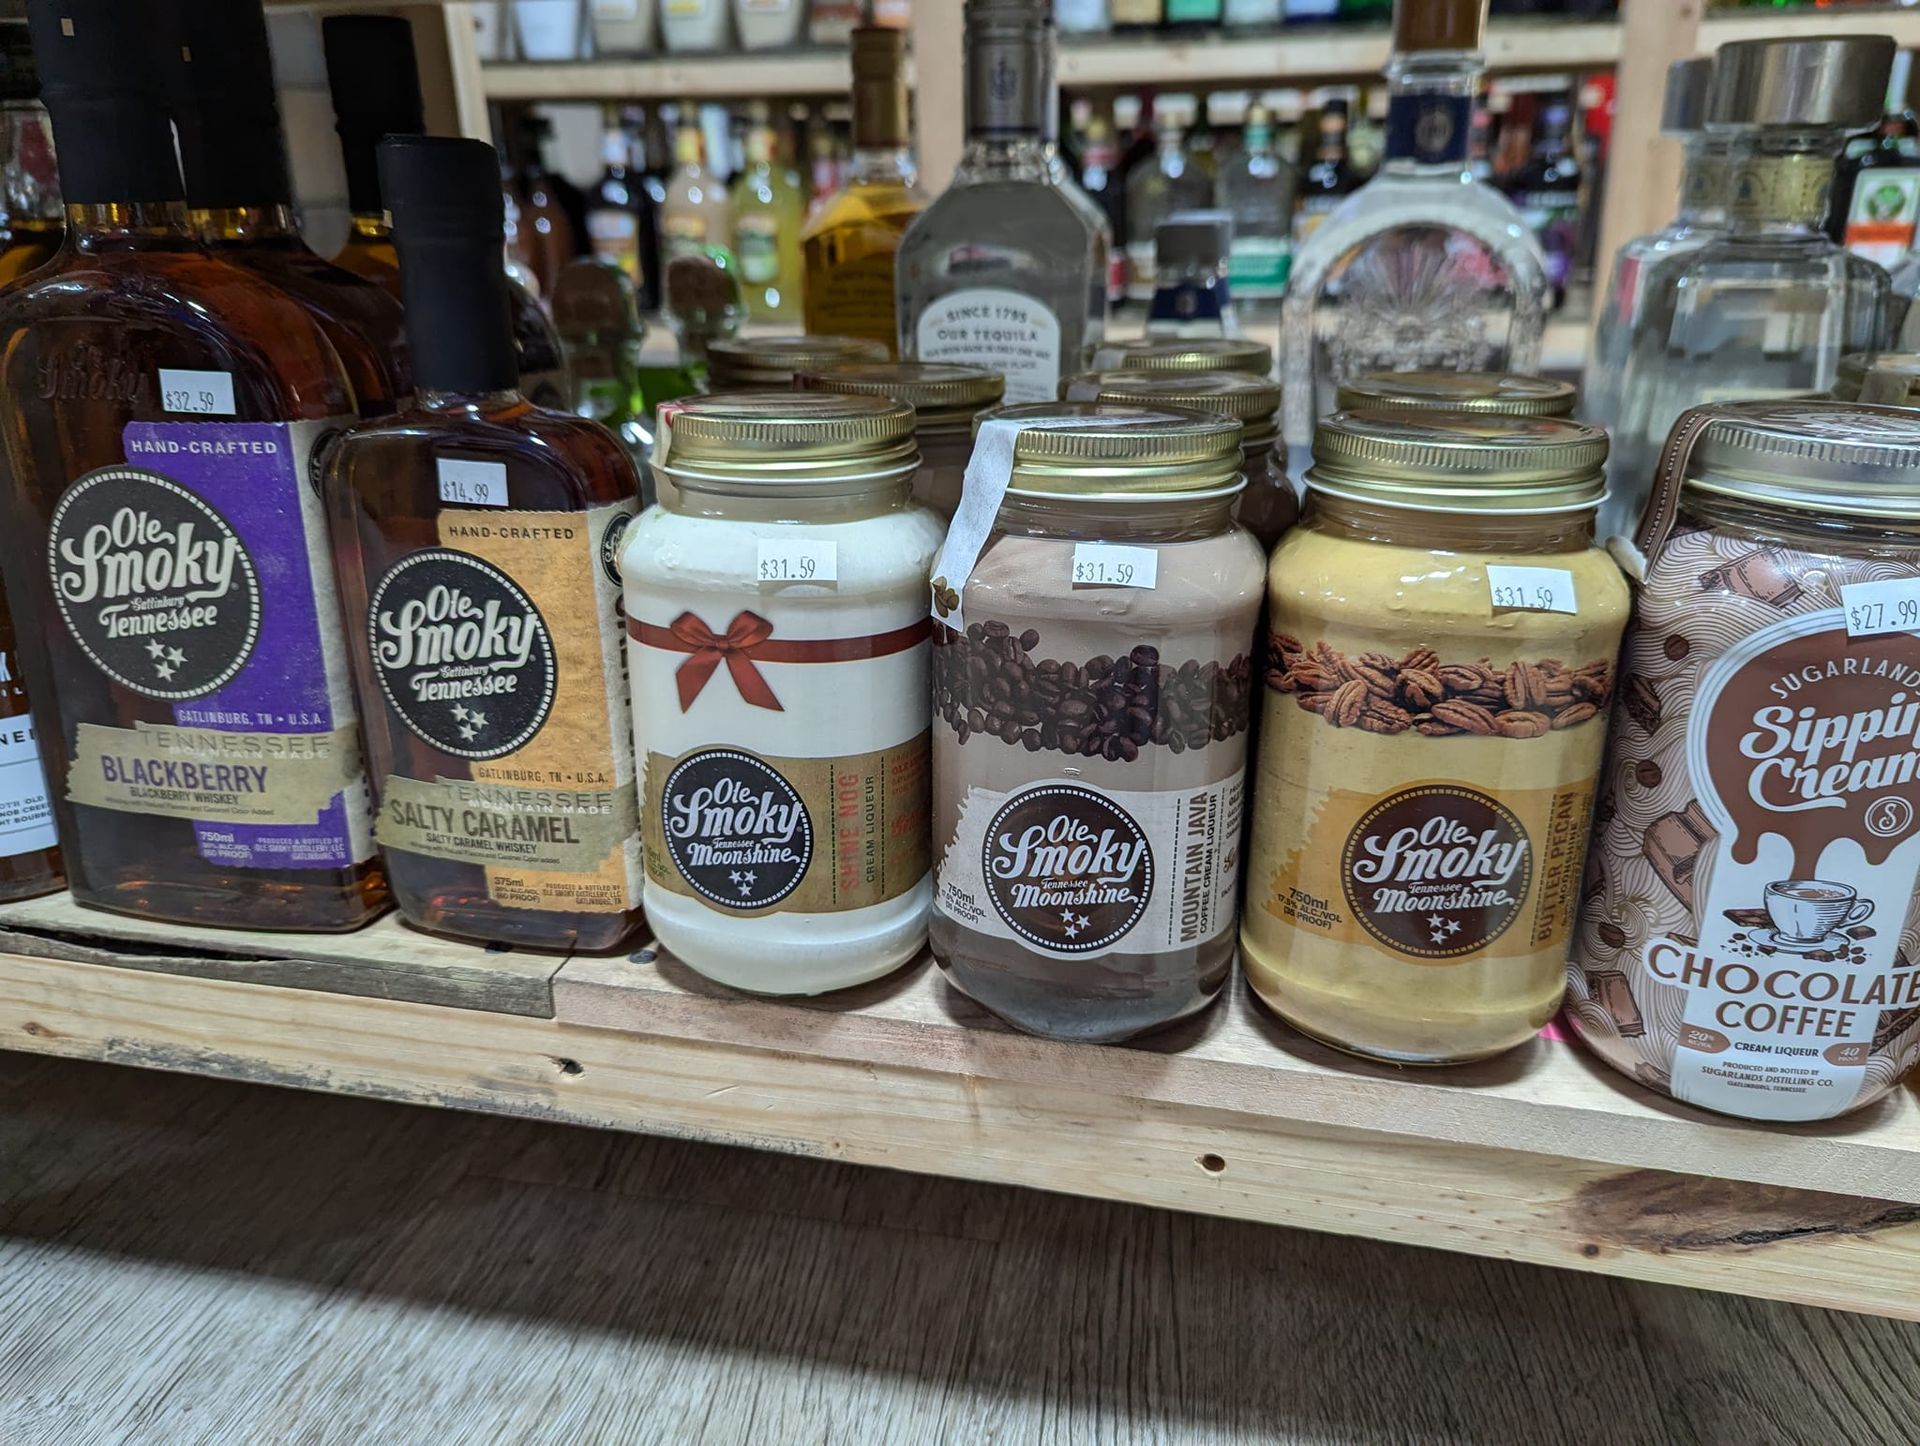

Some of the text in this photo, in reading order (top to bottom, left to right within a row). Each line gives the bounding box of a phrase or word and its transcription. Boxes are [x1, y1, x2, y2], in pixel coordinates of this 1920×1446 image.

[947, 307, 990, 322] SINCE
[937, 330, 1038, 341] OUR TEQUILA
[165, 390, 214, 411] $32.59
[132, 440, 278, 455] HAND-CRAFTED
[443, 483, 489, 502] $14.99
[111, 507, 175, 547] Ole
[450, 526, 574, 540] HAND-CRAFTED
[60, 523, 238, 603] Smoky
[760, 556, 816, 580] $31.59
[1076, 562, 1134, 584] $31.59
[427, 585, 483, 622] Ole
[1494, 586, 1553, 610] $31.59
[100, 603, 218, 638] Tennessee
[1850, 599, 1918, 630] $27.99
[379, 600, 538, 671] Smoky
[410, 672, 518, 701] Tennessee
[178, 709, 326, 727] GATLINBURG, TN U.S.A.
[138, 730, 330, 753] TENNESSEE
[101, 755, 267, 793] BLACKBERRY
[479, 767, 609, 783] GATLINBURG, TN U.S.A.
[130, 786, 190, 801] BLACKBERRY
[194, 792, 239, 805] WHISKEY
[443, 784, 613, 808] TENNESSEE
[714, 777, 759, 805] Ole
[839, 773, 859, 817] NOG
[468, 799, 611, 815] MOUNTAIN MADE
[670, 788, 804, 844] Smoky
[391, 799, 580, 844] SALTY CARAMEL
[866, 776, 875, 883] CREAM LIQUEUR
[1047, 815, 1098, 843] Ole
[1420, 815, 1476, 847] Ole
[200, 831, 234, 843] 750ml
[426, 833, 537, 854] SALTY CARAMEL WHISKEY
[712, 837, 755, 849] Tennessee
[687, 842, 800, 866] Moonshine
[992, 825, 1146, 885] Smoky
[1200, 794, 1217, 934] COFFEE CREAM LIQUEUR
[1353, 828, 1528, 887] Smoky
[1180, 792, 1208, 943] MOUNTAIN JAVA
[1538, 792, 1575, 942] BUTTER PECAN
[494, 876, 524, 887] 375ml
[947, 882, 975, 905] 750ml
[1041, 878, 1088, 889] Tennessee
[1409, 881, 1462, 893] Tennessee
[1010, 882, 1139, 908] Moonshine
[1289, 886, 1328, 911] 750ml
[1373, 886, 1515, 913] Moonshine
[1296, 911, 1332, 931] PROOF)
[1715, 1000, 1856, 1038] COFFEE
[1735, 1042, 1819, 1057] CREAM LIQUEUR
[1840, 1047, 1860, 1056] 40
[1702, 1065, 1834, 1087] SUGARLANDS DISTILLING CO.
[1722, 1061, 1763, 1072] PRODUCED
[1780, 1068, 1809, 1076] BOTTLED
